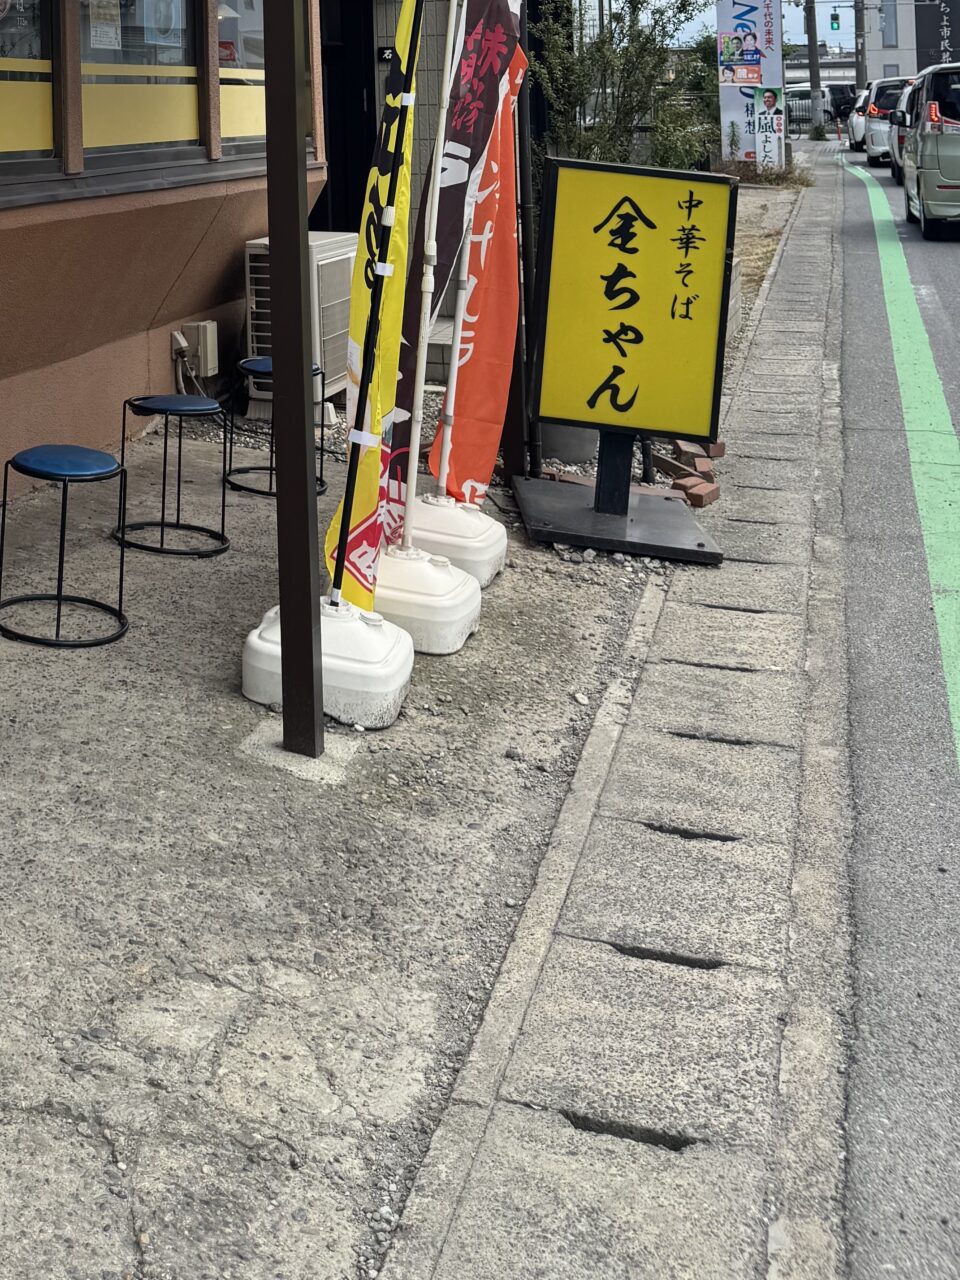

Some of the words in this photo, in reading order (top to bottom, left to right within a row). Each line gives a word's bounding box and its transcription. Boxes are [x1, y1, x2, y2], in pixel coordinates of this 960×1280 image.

[586, 195, 658, 413] 金ちゃん
[670, 189, 707, 321] 中華そば
